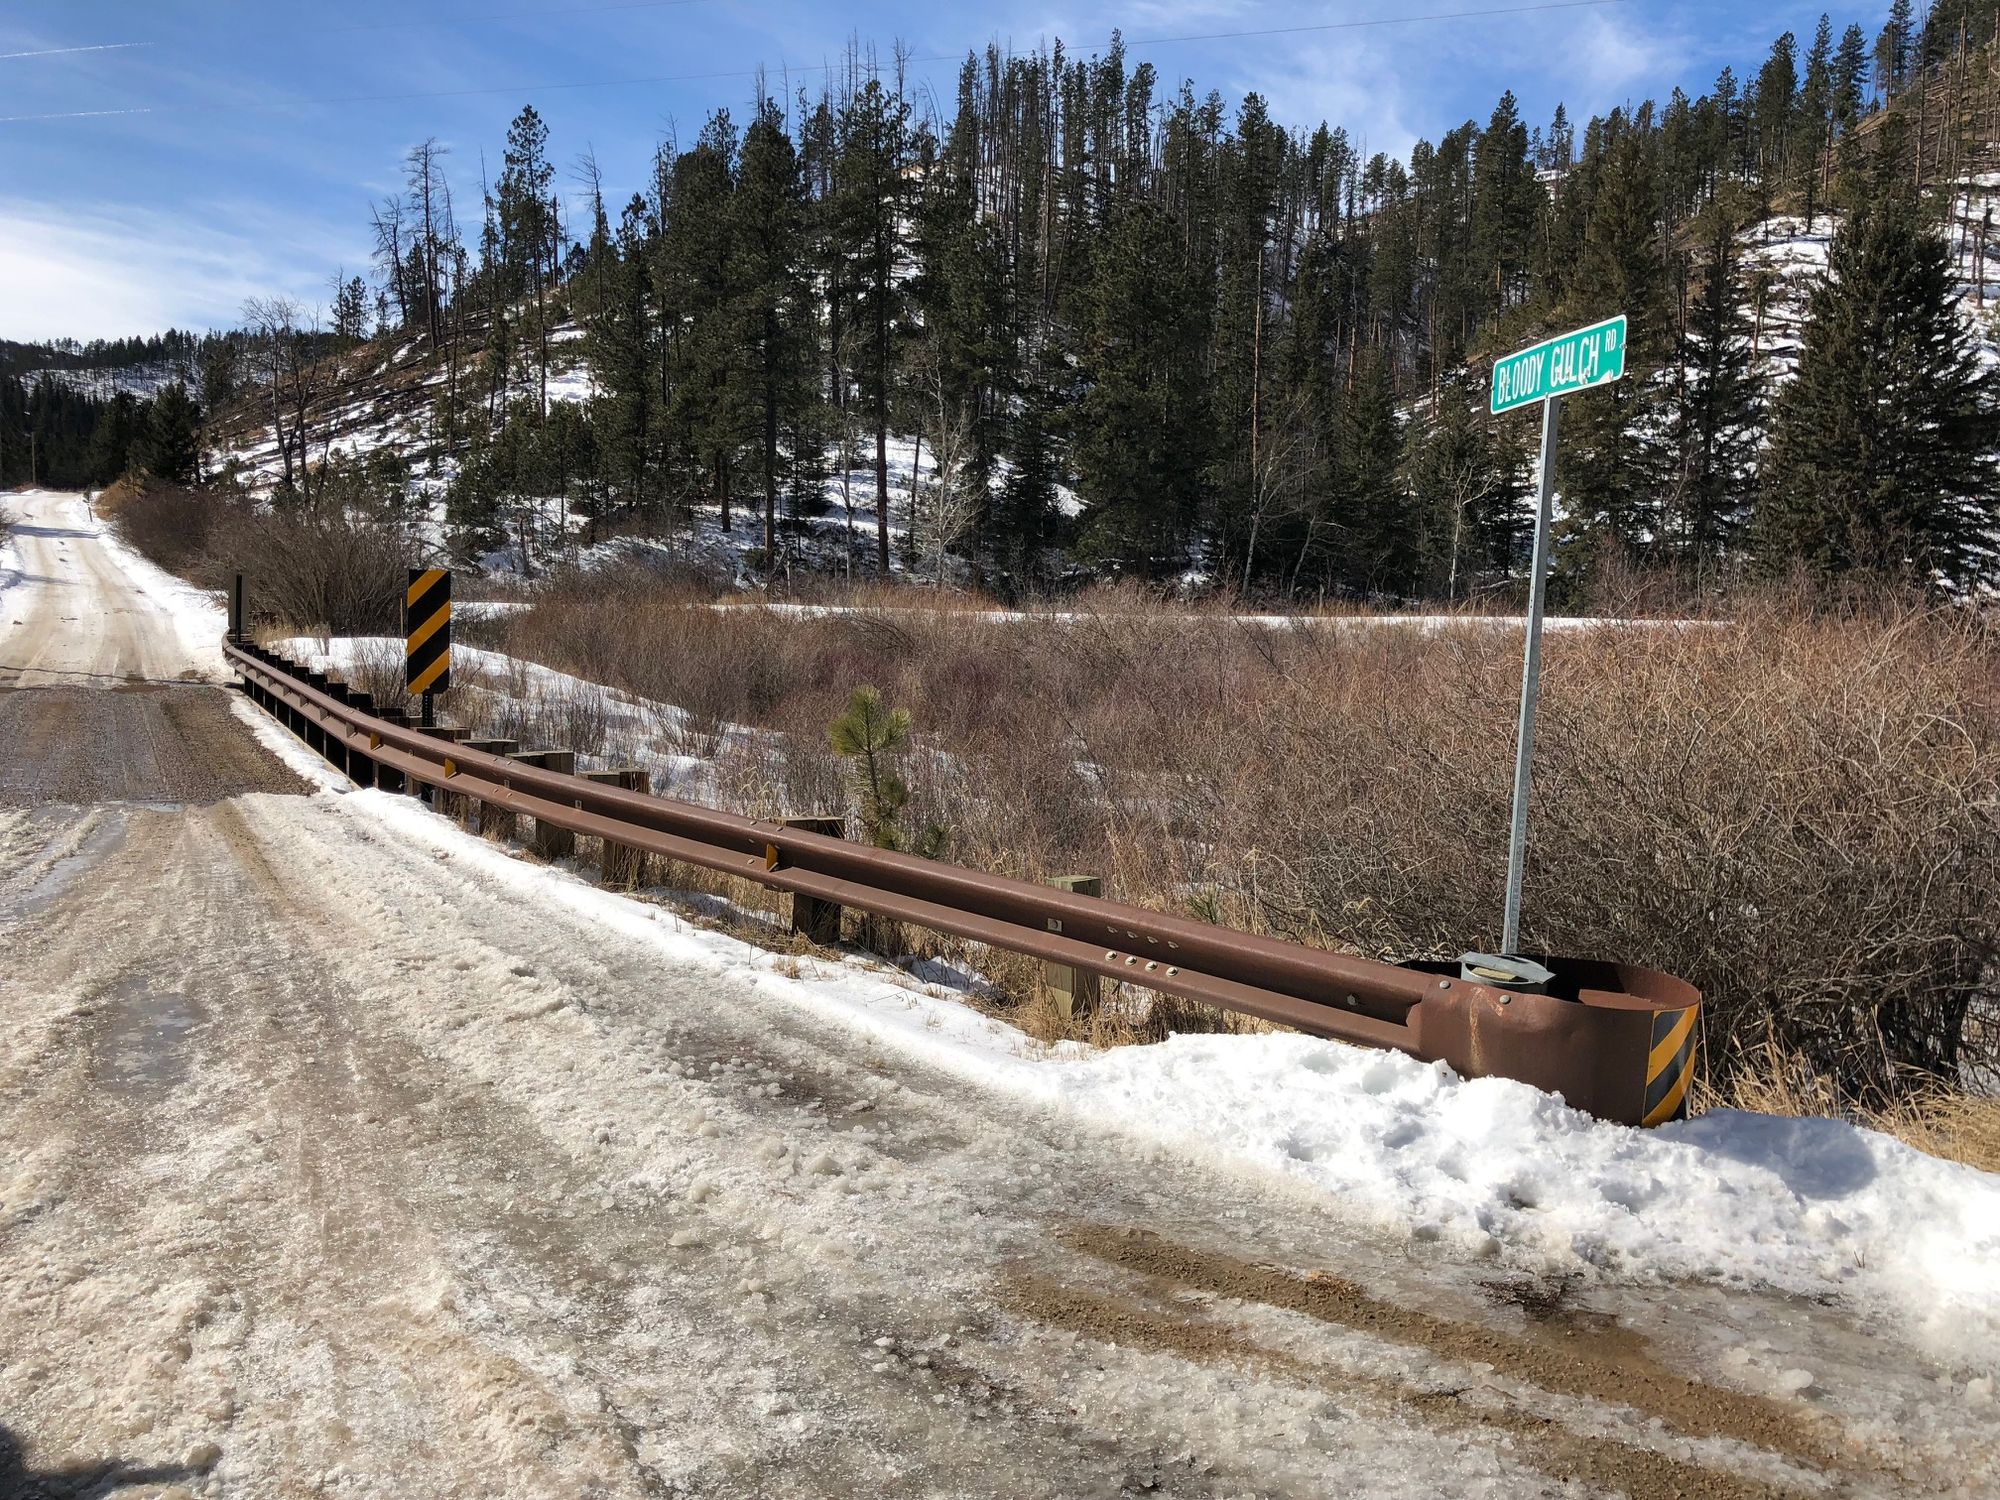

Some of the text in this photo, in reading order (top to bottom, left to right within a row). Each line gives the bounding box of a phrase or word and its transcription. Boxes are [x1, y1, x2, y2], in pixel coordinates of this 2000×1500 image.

[1497, 328, 1617, 405] BLOODY GULCH RD
